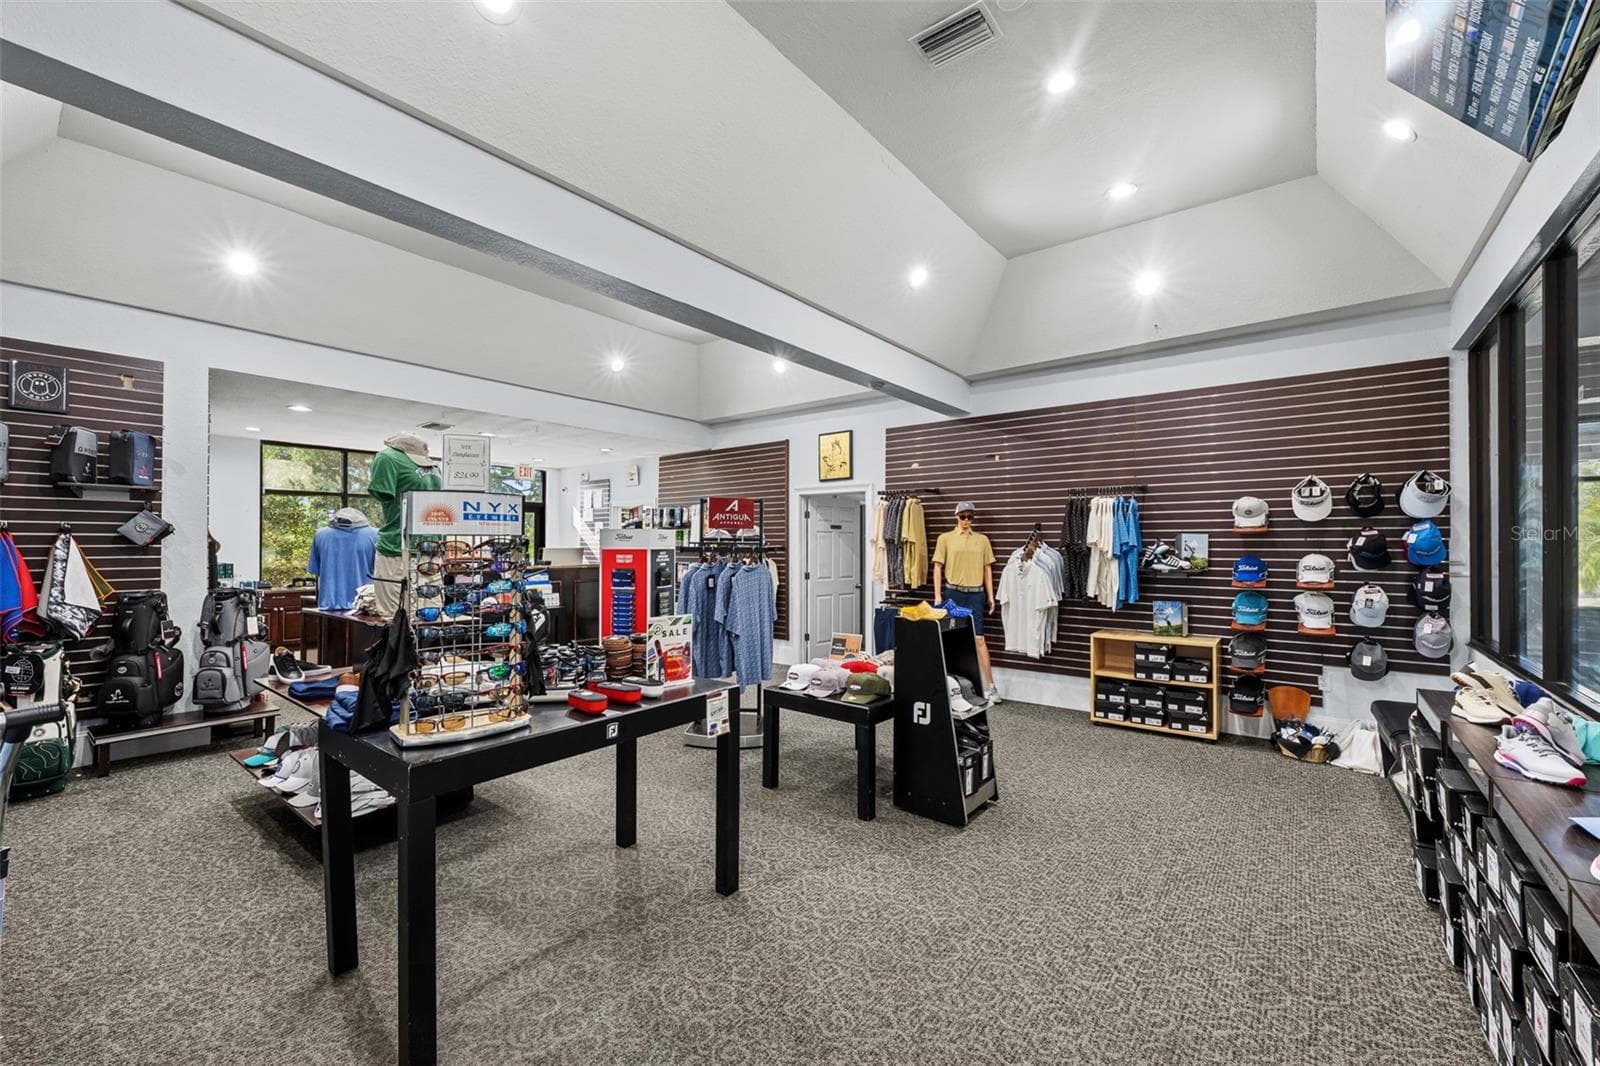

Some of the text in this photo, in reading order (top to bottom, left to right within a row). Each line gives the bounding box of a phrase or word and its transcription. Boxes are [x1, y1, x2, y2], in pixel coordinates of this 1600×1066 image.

[1479, 30, 1493, 52] TODAY
[1503, 26, 1517, 41] USA
[1477, 52, 1488, 64] CUP
[1519, 36, 1540, 72] POSTGAME
[1431, 60, 1440, 73] FIFA
[1446, 63, 1458, 82] MATCH
[1472, 62, 1485, 83] WORLD
[1494, 58, 1509, 79] GROUP
[1515, 68, 1530, 84] CUP
[1471, 81, 1482, 95] FIFA
[1488, 83, 1502, 104] MATCH
[1509, 81, 1525, 103] WORLD
[1507, 100, 1519, 114] FIFA
[519, 467, 532, 478] EXIT
[463, 501, 519, 514] NYX
[712, 513, 751, 522] ANTIGUA
[661, 628, 688, 638] SALE
[913, 701, 931, 725] FJ
